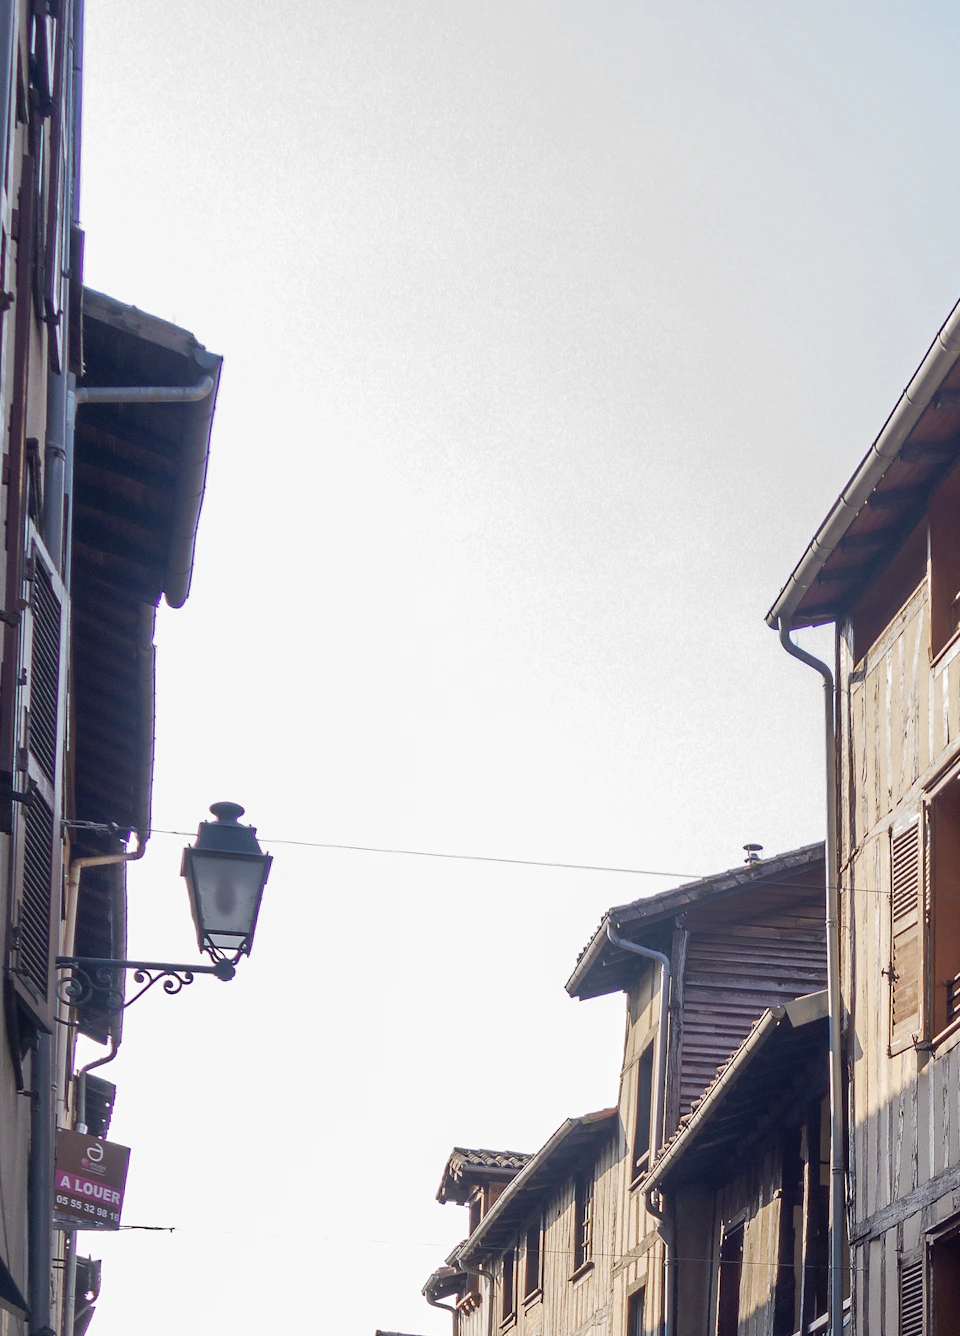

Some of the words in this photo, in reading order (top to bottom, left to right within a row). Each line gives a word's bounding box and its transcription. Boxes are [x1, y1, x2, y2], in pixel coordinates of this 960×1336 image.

[60, 1175, 71, 1189] A
[75, 1179, 120, 1205] LOUER
[56, 1195, 69, 1205] 05
[70, 1199, 82, 1210] 55
[83, 1203, 95, 1214] 32
[96, 1207, 108, 1218] 98
[109, 1212, 119, 1222] 16
